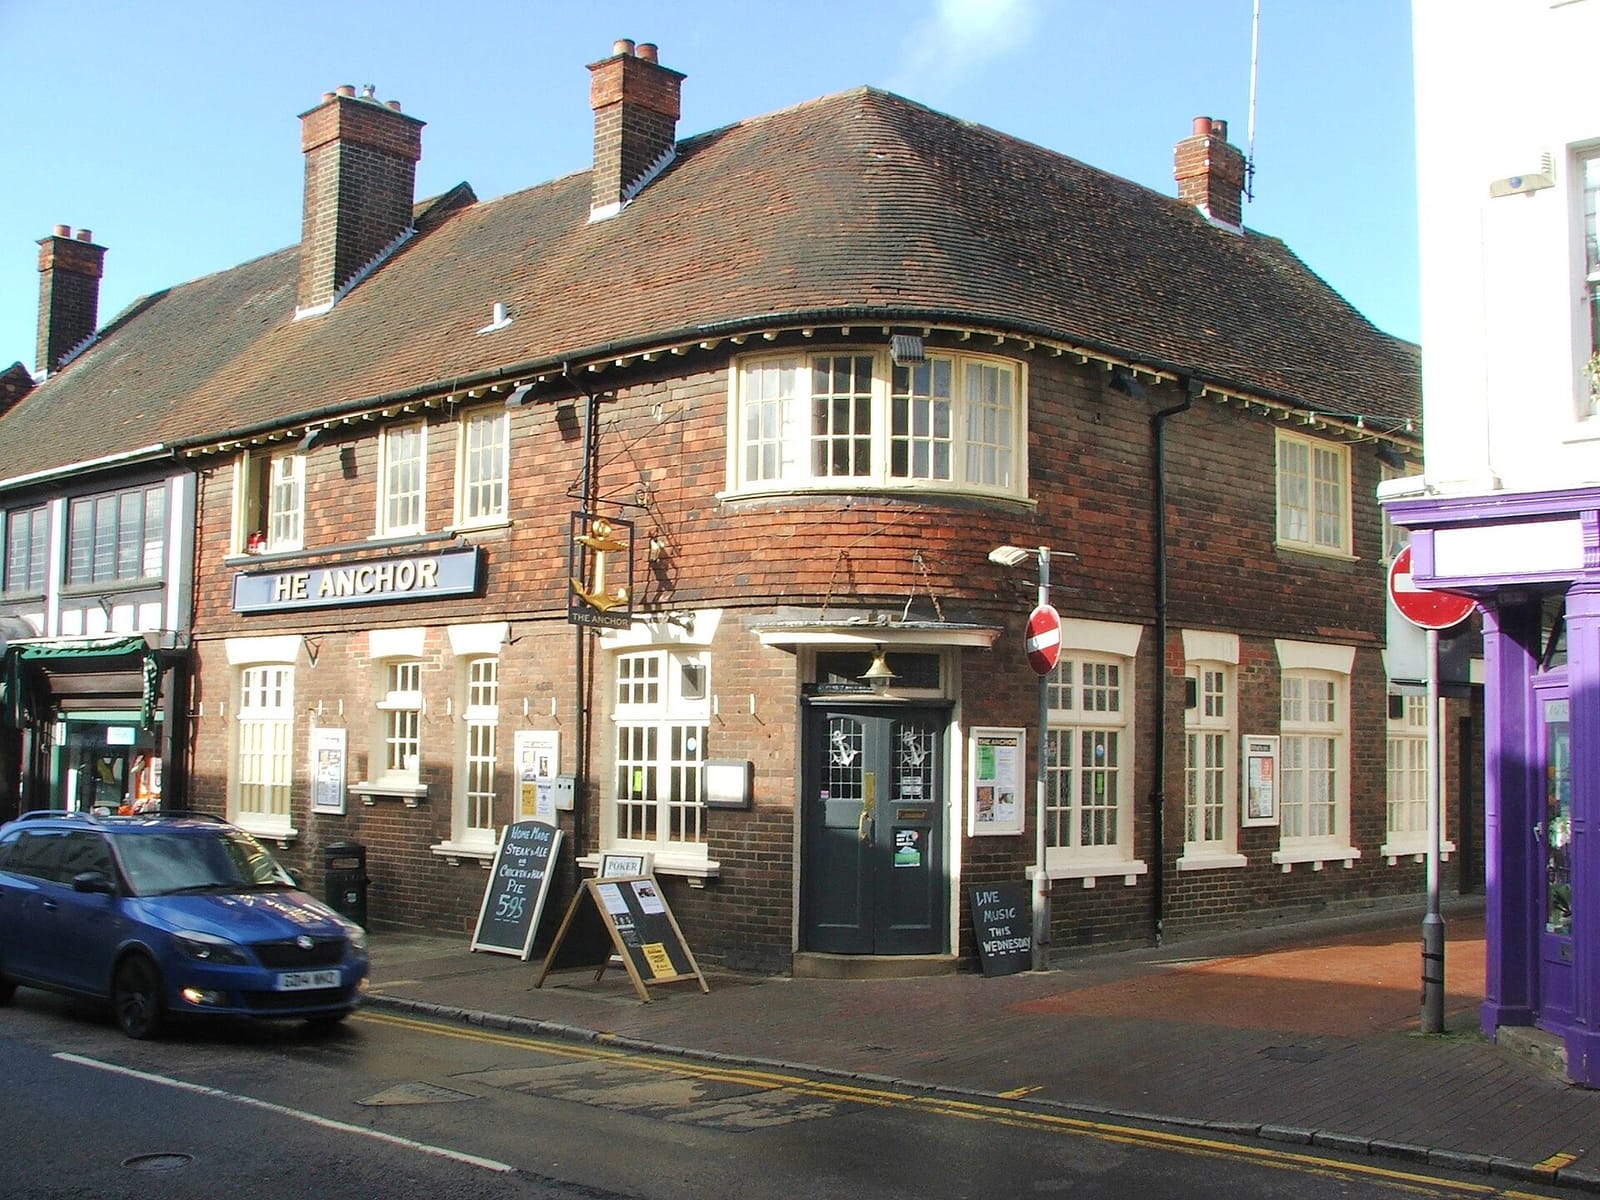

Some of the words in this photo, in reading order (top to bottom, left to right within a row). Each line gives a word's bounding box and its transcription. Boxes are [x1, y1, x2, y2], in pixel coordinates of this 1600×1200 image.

[317, 558, 438, 597] ANCHOR
[573, 612, 590, 622] THE
[592, 615, 629, 626] ANCHOR
[511, 826, 531, 839] HOME
[531, 827, 550, 841] MADE
[505, 843, 531, 856] STEAK
[534, 846, 548, 857] ALE
[500, 864, 528, 877] CHICKEN
[608, 861, 638, 872] POKER
[507, 879, 526, 894] PIE
[976, 891, 1000, 906] LIVE
[984, 907, 1016, 923] MUSIC
[988, 926, 1012, 938] THIS
[983, 937, 1031, 952] WEDNESDAY
